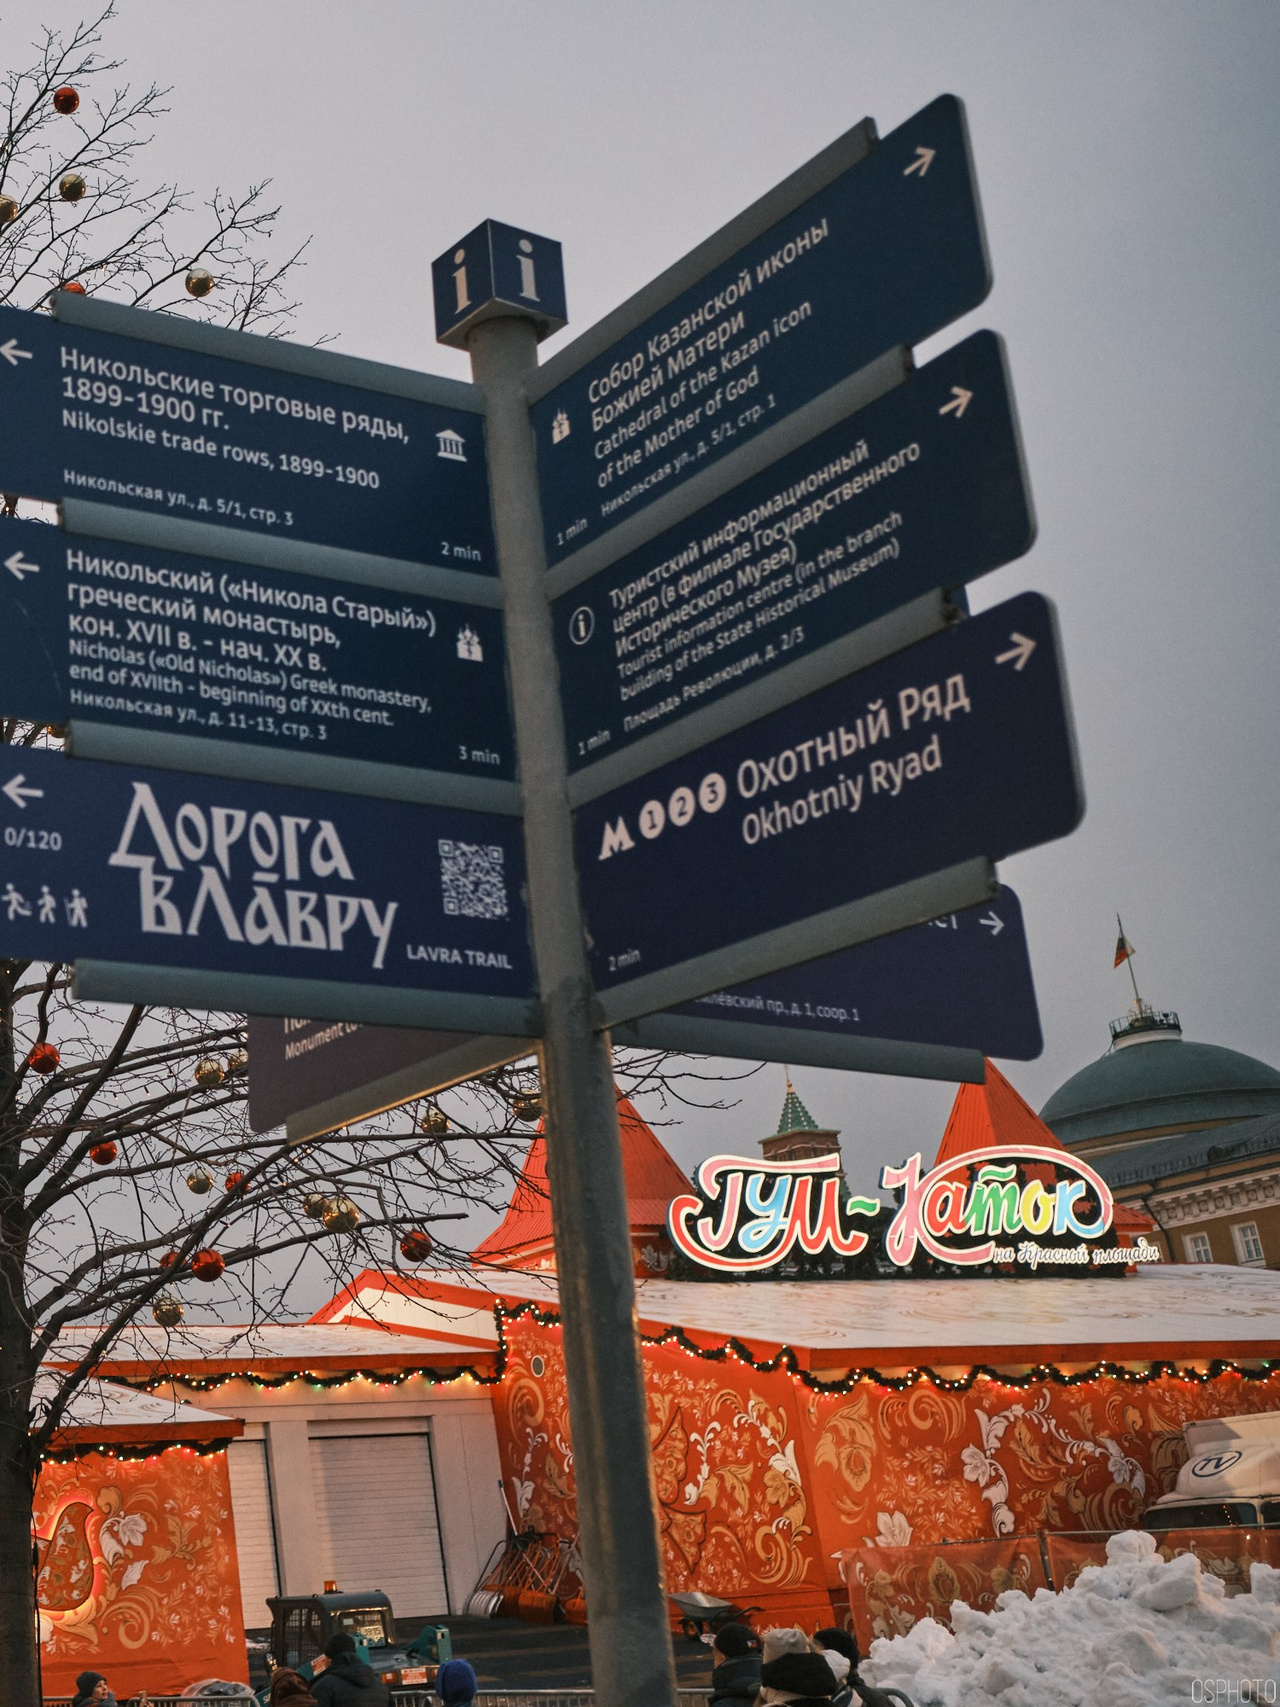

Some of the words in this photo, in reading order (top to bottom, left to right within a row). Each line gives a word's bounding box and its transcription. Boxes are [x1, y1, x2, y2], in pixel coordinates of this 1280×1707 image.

[588, 352, 645, 404] Собор
[647, 268, 753, 362] Казанской
[755, 217, 829, 284] иконы
[60, 346, 215, 400] Никольские
[219, 384, 337, 425] торговые
[342, 410, 410, 445] ряды,
[591, 364, 664, 433] Божией
[667, 310, 746, 380] Матери
[594, 395, 669, 460] Cathedral
[670, 380, 686, 409] of
[688, 365, 718, 395] the
[720, 328, 771, 375] Kazan
[772, 300, 813, 338] icon
[62, 376, 196, 422] 1899-1900
[201, 408, 230, 430] гг.
[597, 462, 615, 489] of
[616, 447, 642, 477] the
[644, 406, 702, 458] Mother
[705, 387, 724, 417] of
[725, 364, 760, 402] God
[766, 393, 777, 409] 1
[62, 409, 156, 444] Nikolskie
[161, 430, 217, 457] trade
[222, 444, 275, 471] rows,
[279, 454, 380, 489] 1899-1900
[63, 469, 163, 501] Никольская
[249, 507, 281, 525] стр.
[284, 511, 294, 526] 3
[608, 541, 701, 610] Туристский
[701, 438, 870, 555] информационный
[440, 541, 450, 556] 2
[453, 543, 482, 562] min
[556, 531, 565, 547] 1
[565, 516, 589, 541] min
[612, 595, 660, 634] центр
[660, 584, 677, 609] (в
[677, 541, 753, 598] филиале
[753, 442, 921, 551] Государственного
[66, 549, 215, 595] Никольский
[615, 579, 735, 658] Исторического
[736, 538, 797, 590] Музея)
[617, 645, 664, 680] Tourist
[664, 600, 745, 654] information
[746, 573, 794, 609] centre
[794, 560, 816, 585] (in
[817, 544, 845, 569] the
[845, 511, 903, 553] branch
[67, 583, 197, 622] греческий
[203, 605, 341, 649] монастырь,
[69, 614, 121, 639] кон.
[177, 630, 197, 651] в.
[220, 638, 270, 663] нач.
[307, 652, 327, 672] в.
[620, 664, 673, 702] building
[673, 650, 690, 673] of
[690, 640, 715, 664] the
[715, 620, 754, 650] State
[754, 577, 827, 629] Historical
[827, 536, 901, 590] Museum)
[69, 638, 146, 666] Nicholas
[290, 673, 339, 696] Greek
[69, 663, 104, 683] end
[107, 667, 128, 686] of
[199, 680, 287, 714] beginning
[290, 696, 309, 712] of
[310, 699, 350, 720] XXth
[70, 688, 174, 718] Никольская
[317, 724, 327, 741] 3
[577, 740, 586, 756] 1
[587, 729, 611, 751] min
[623, 695, 682, 733] Площадь
[736, 698, 891, 799] Охотный
[898, 673, 972, 730] Ряд
[458, 745, 468, 761] 3
[471, 747, 501, 767] min
[741, 774, 864, 845] Okhotniy
[869, 734, 943, 797] Ryad
[4, 826, 63, 852] 0/120
[406, 944, 463, 966] LAVRA
[463, 949, 513, 970] TRAIL
[608, 956, 617, 971] 2
[617, 947, 642, 968] min
[285, 1022, 344, 1060] Monument
[852, 1008, 860, 1022] 1
[993, 1245, 1016, 1264] на
[1017, 1240, 1090, 1271] Красной
[1092, 1236, 1161, 1266] площади
